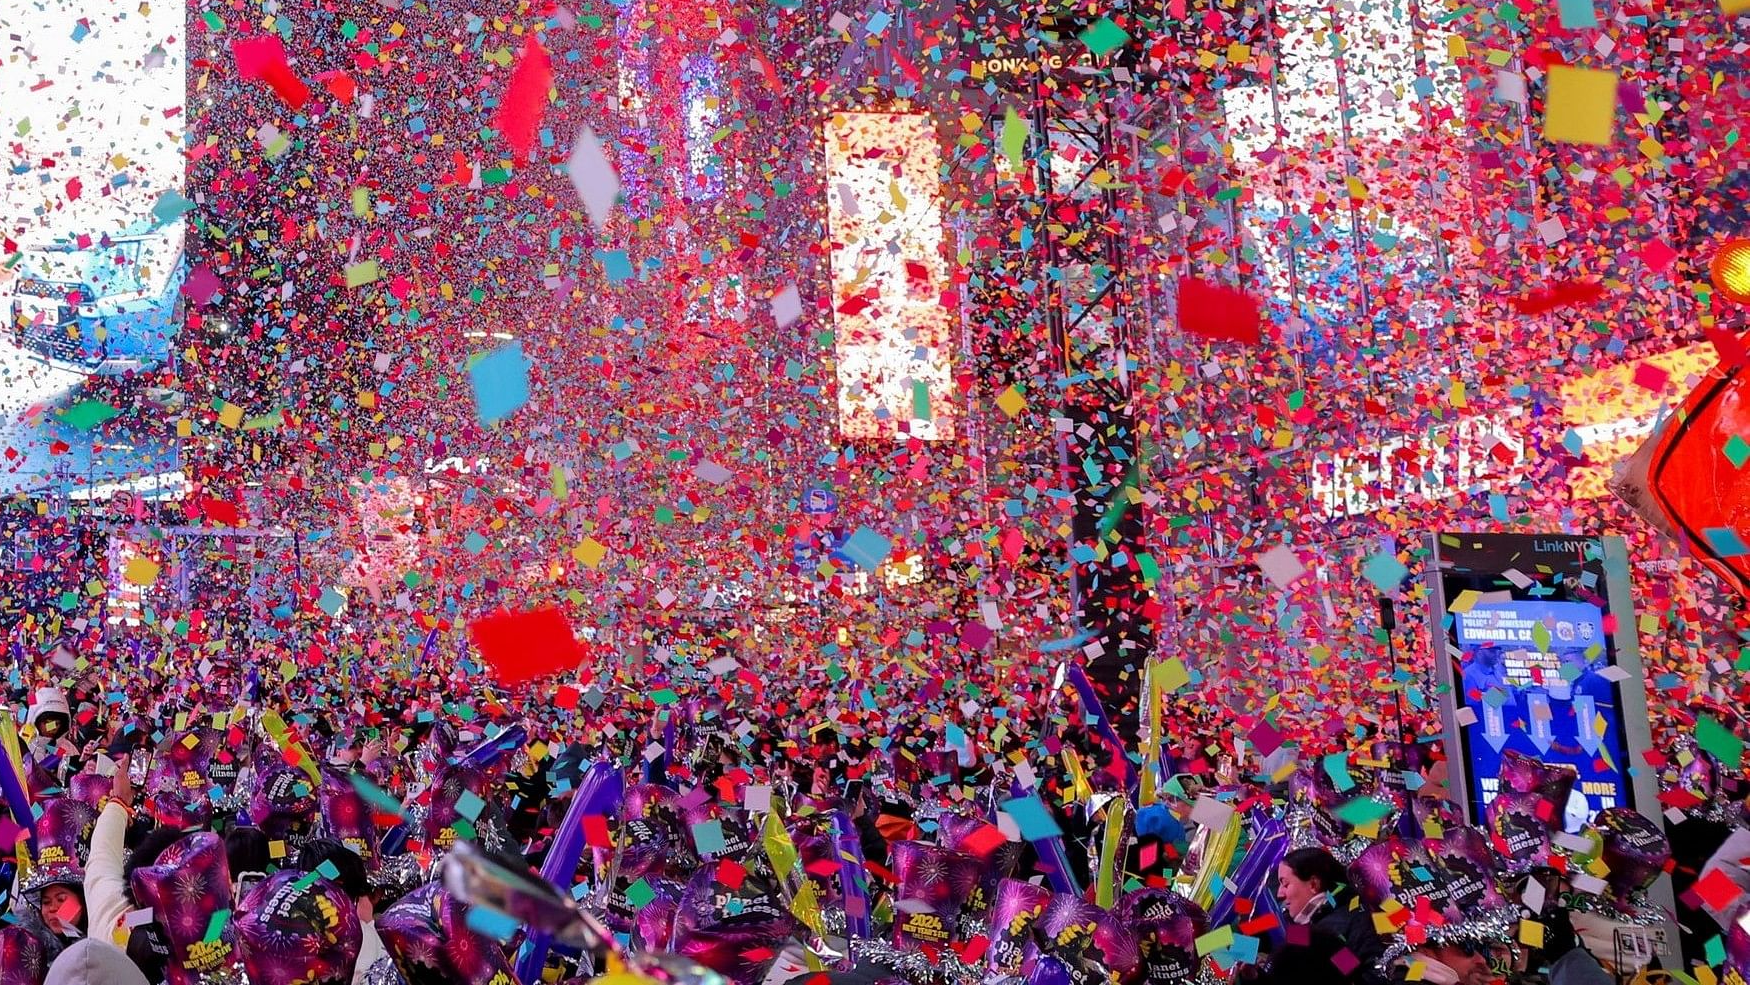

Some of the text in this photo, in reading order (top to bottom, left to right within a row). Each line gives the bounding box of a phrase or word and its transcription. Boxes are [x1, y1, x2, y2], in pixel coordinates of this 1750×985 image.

[1464, 629, 1505, 640] EDWARD
[209, 763, 233, 772] planet
[211, 770, 237, 778] fitness
[1582, 782, 1616, 796] MORE
[40, 846, 64, 858] 2024
[1399, 882, 1436, 903] planet
[910, 913, 942, 929] 2024
